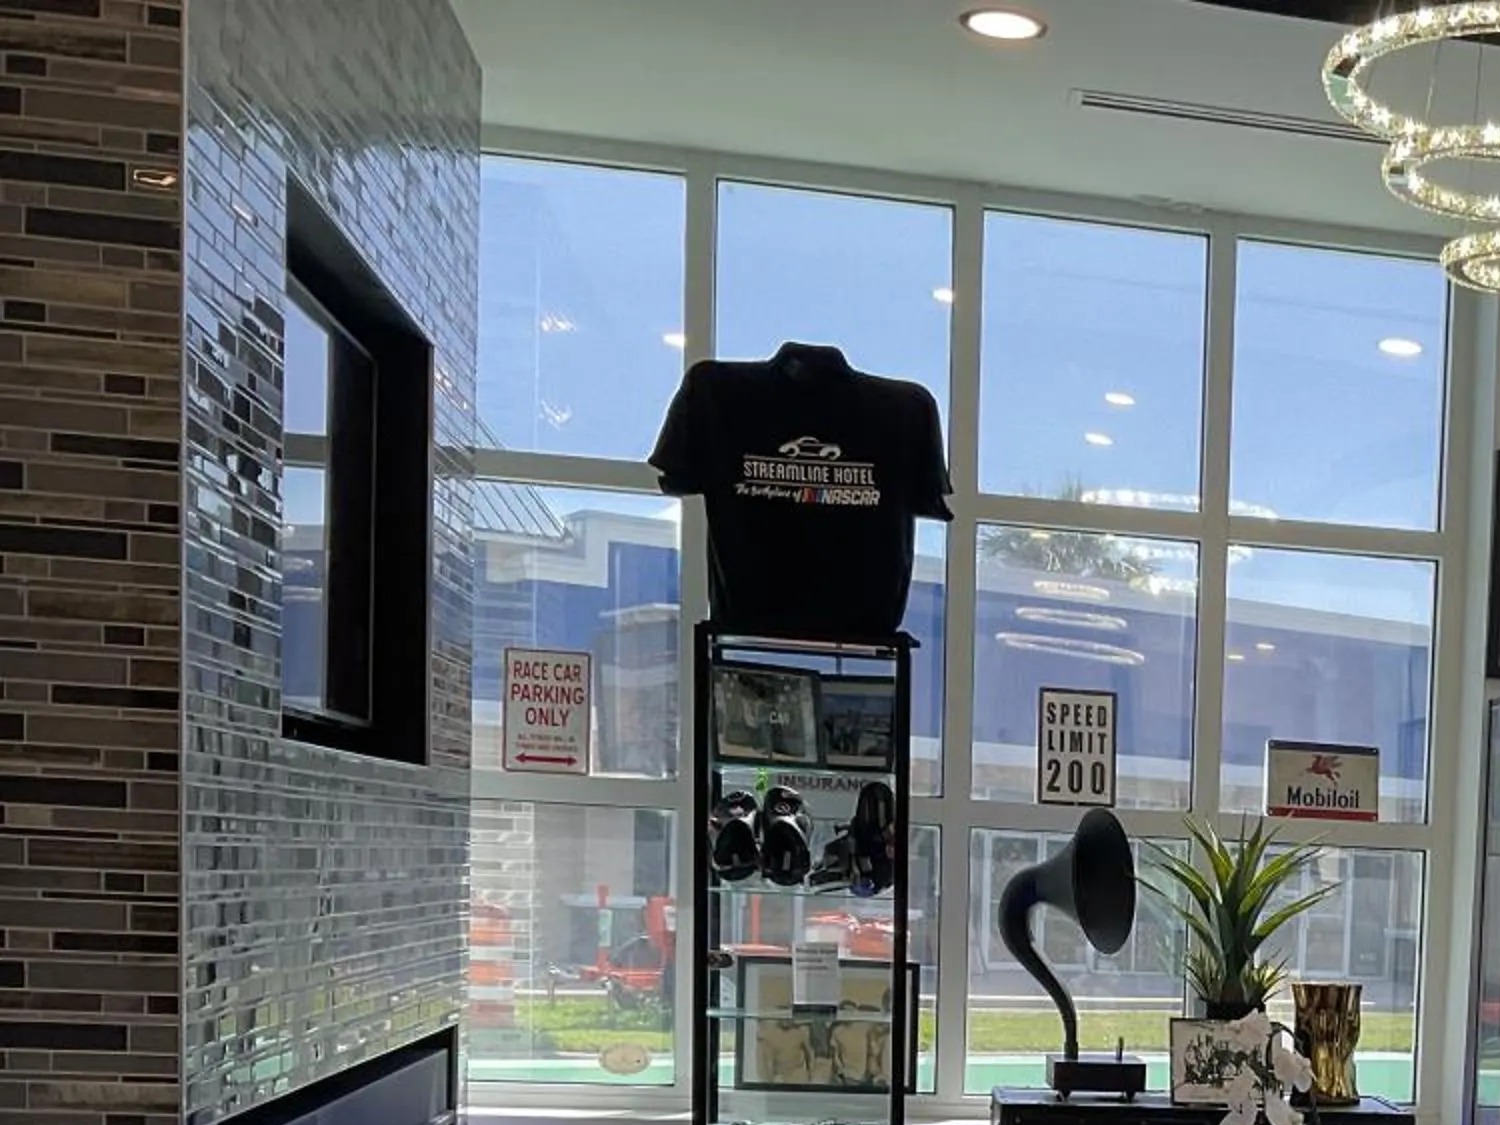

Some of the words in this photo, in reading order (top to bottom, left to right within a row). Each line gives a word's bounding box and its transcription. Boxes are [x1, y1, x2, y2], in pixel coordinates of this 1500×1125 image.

[743, 461, 830, 483] STREAMLINE
[833, 467, 875, 485] HOTEL
[821, 486, 881, 505] NASCAR
[513, 661, 549, 680] RACE
[553, 663, 582, 682] CAR
[511, 683, 585, 705] PARKING
[525, 707, 570, 727] ONLY
[1046, 702, 1107, 728] SPEED
[1048, 729, 1107, 755] LIMIT
[1046, 759, 1105, 795] 200
[1287, 786, 1360, 809] Mobiloil
